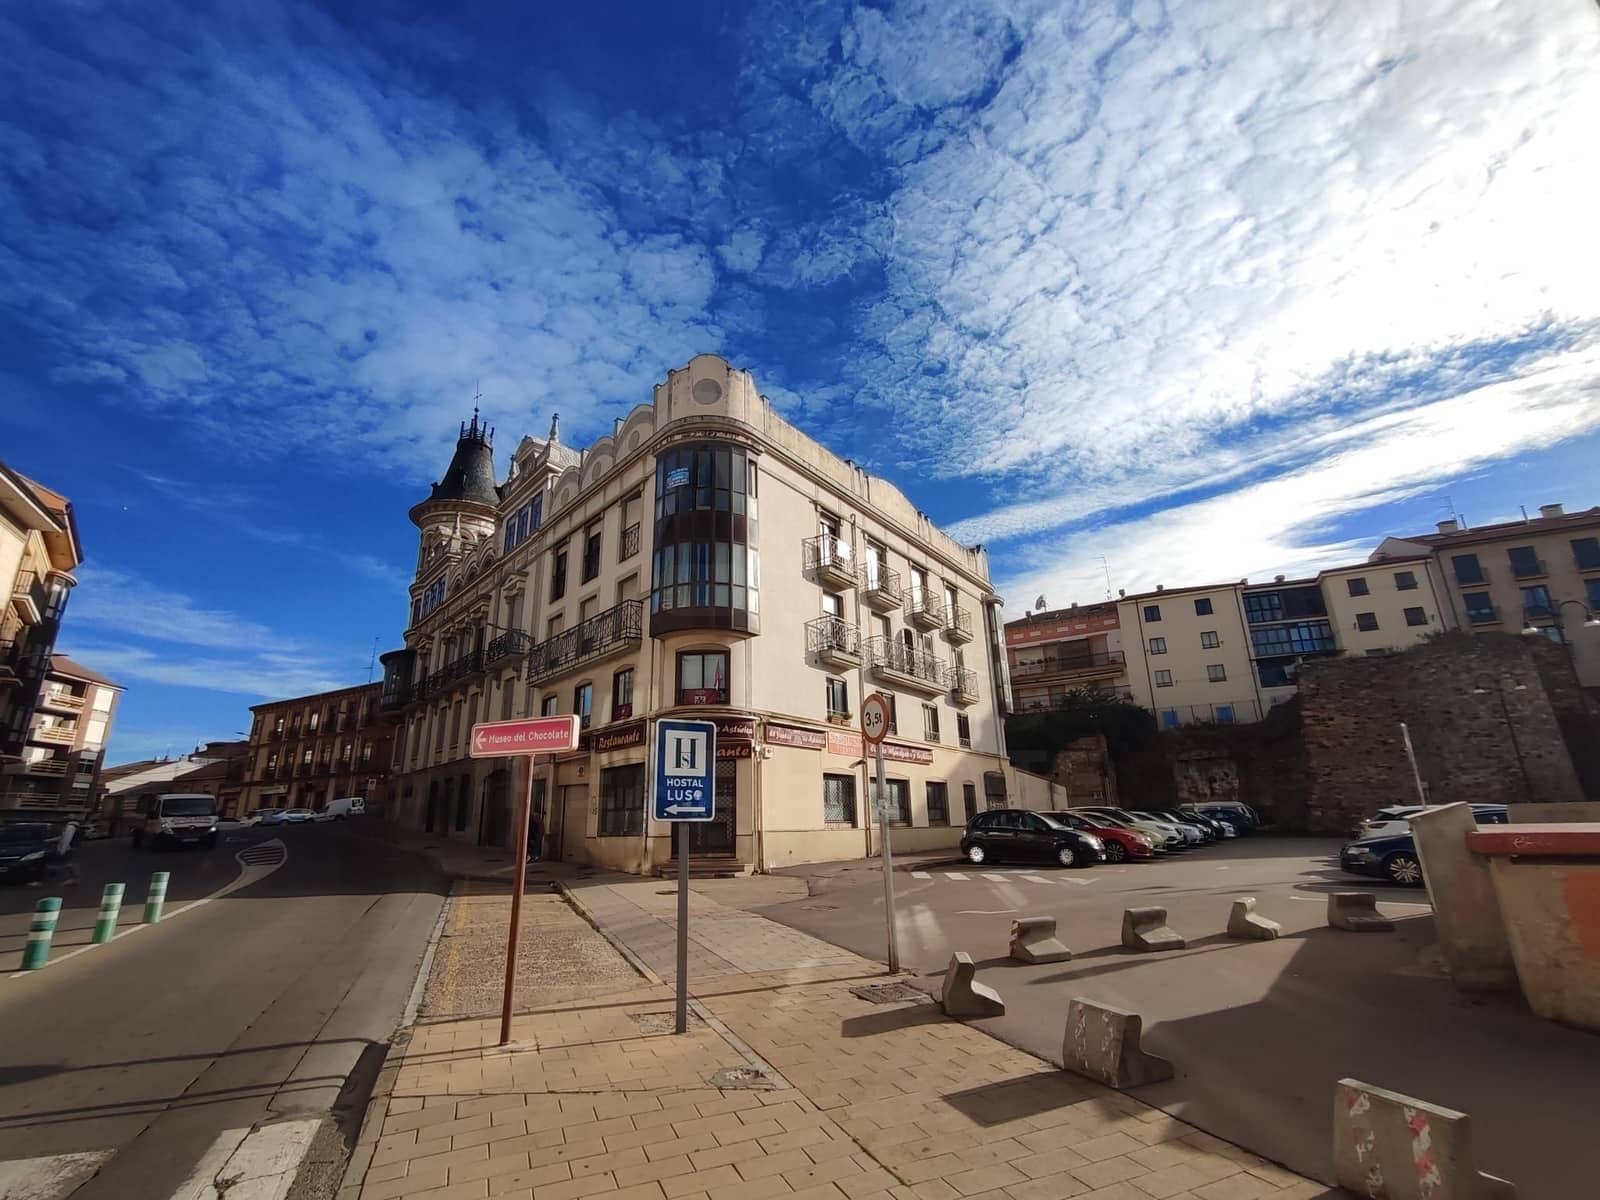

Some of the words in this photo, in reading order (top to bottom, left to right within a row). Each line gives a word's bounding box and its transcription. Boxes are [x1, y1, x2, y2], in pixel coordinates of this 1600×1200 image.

[488, 735, 512, 744] Museo
[513, 732, 525, 742] del
[528, 729, 569, 741] Chocolate
[666, 779, 704, 787] HOSTAL
